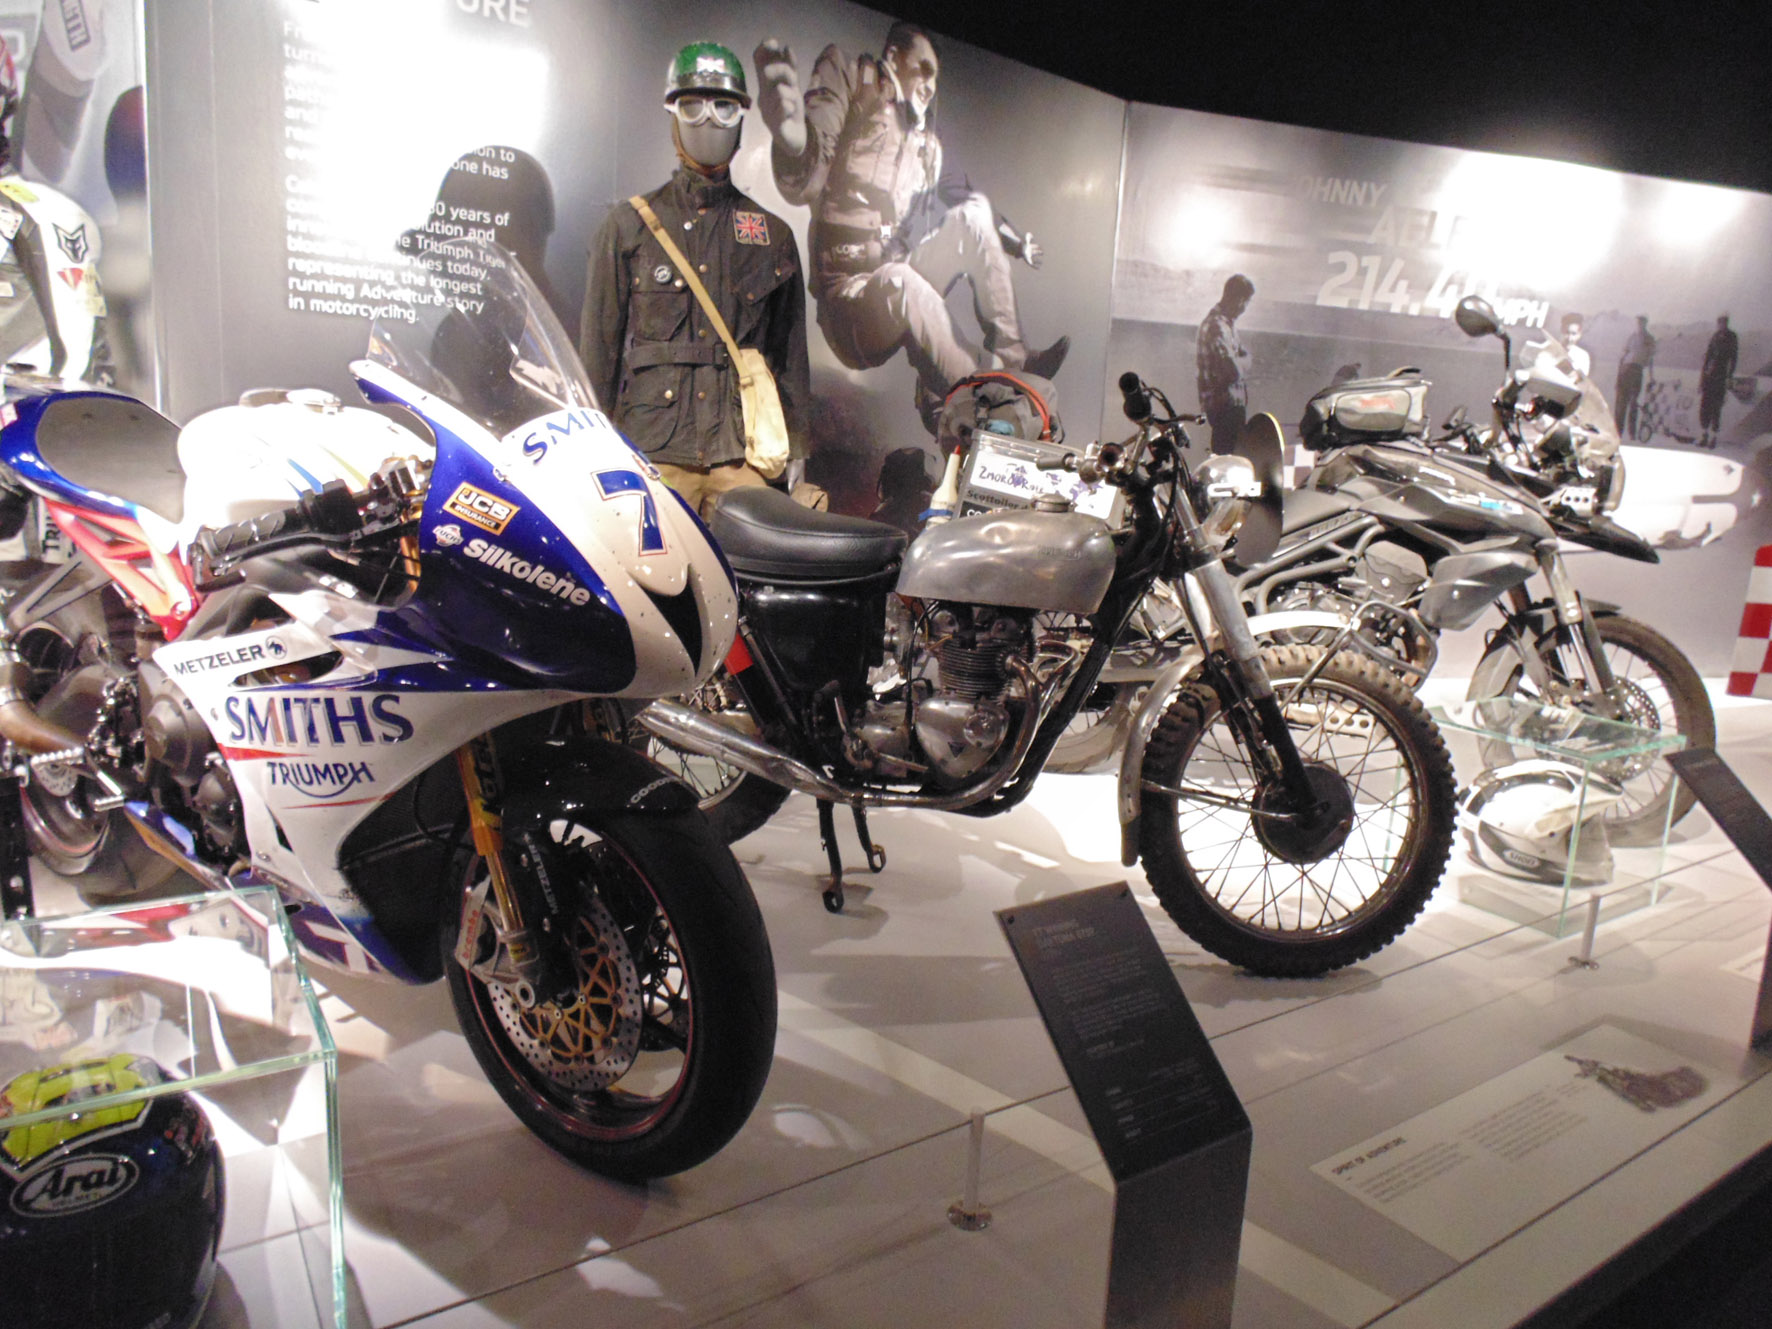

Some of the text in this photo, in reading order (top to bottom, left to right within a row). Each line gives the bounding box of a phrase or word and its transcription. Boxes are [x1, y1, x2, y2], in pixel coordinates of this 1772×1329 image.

[483, 161, 509, 179] has
[500, 148, 516, 163] to
[1297, 175, 1388, 207] OHNNY
[449, 206, 492, 224] years
[495, 212, 510, 226] of
[415, 234, 474, 260] Triumph
[467, 226, 496, 243] and
[287, 276, 355, 300] running
[446, 296, 485, 315] story
[401, 270, 427, 287] the
[430, 273, 483, 295] longest
[287, 292, 305, 311] in
[457, 489, 511, 521] JCB
[463, 538, 591, 606] Silkolene
[173, 644, 266, 676] METZELER
[224, 693, 414, 747] SMITHS
[267, 761, 376, 798] TRIUMPH
[26, 1164, 121, 1206] Arai
